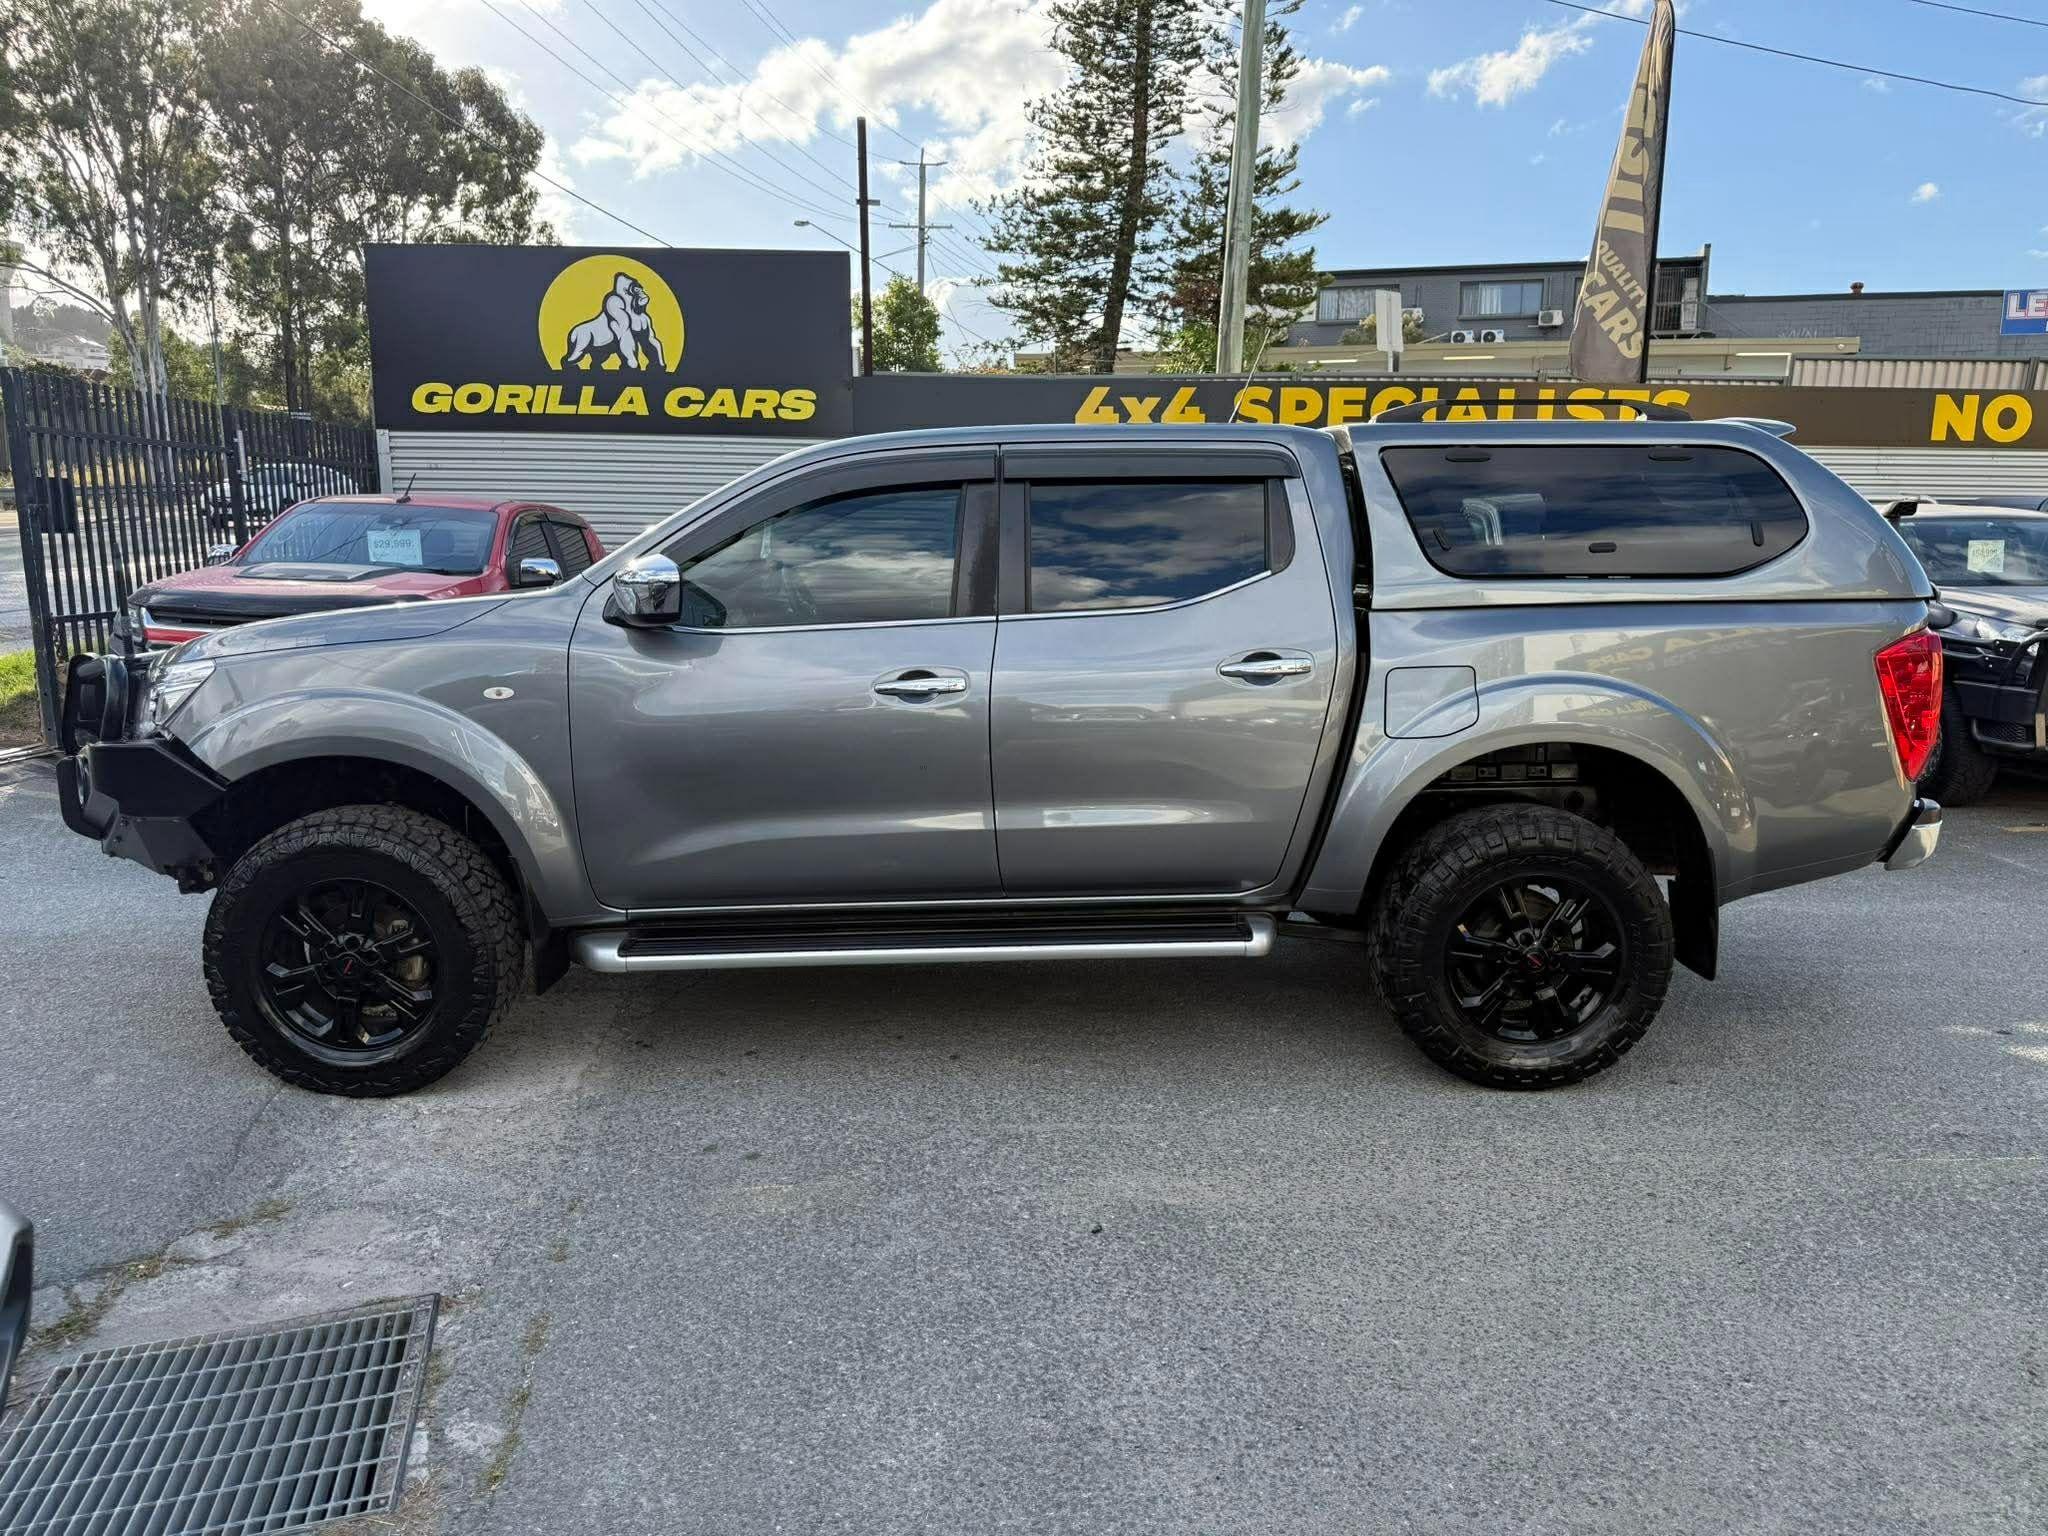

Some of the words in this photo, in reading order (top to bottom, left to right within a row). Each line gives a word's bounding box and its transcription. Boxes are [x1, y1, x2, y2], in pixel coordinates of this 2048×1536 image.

[1580, 271, 1643, 359] CARS
[411, 383, 649, 416] GORILLA
[663, 386, 817, 420] CARS
[1074, 386, 1207, 424] 4x4
[1930, 394, 2033, 443] NO
